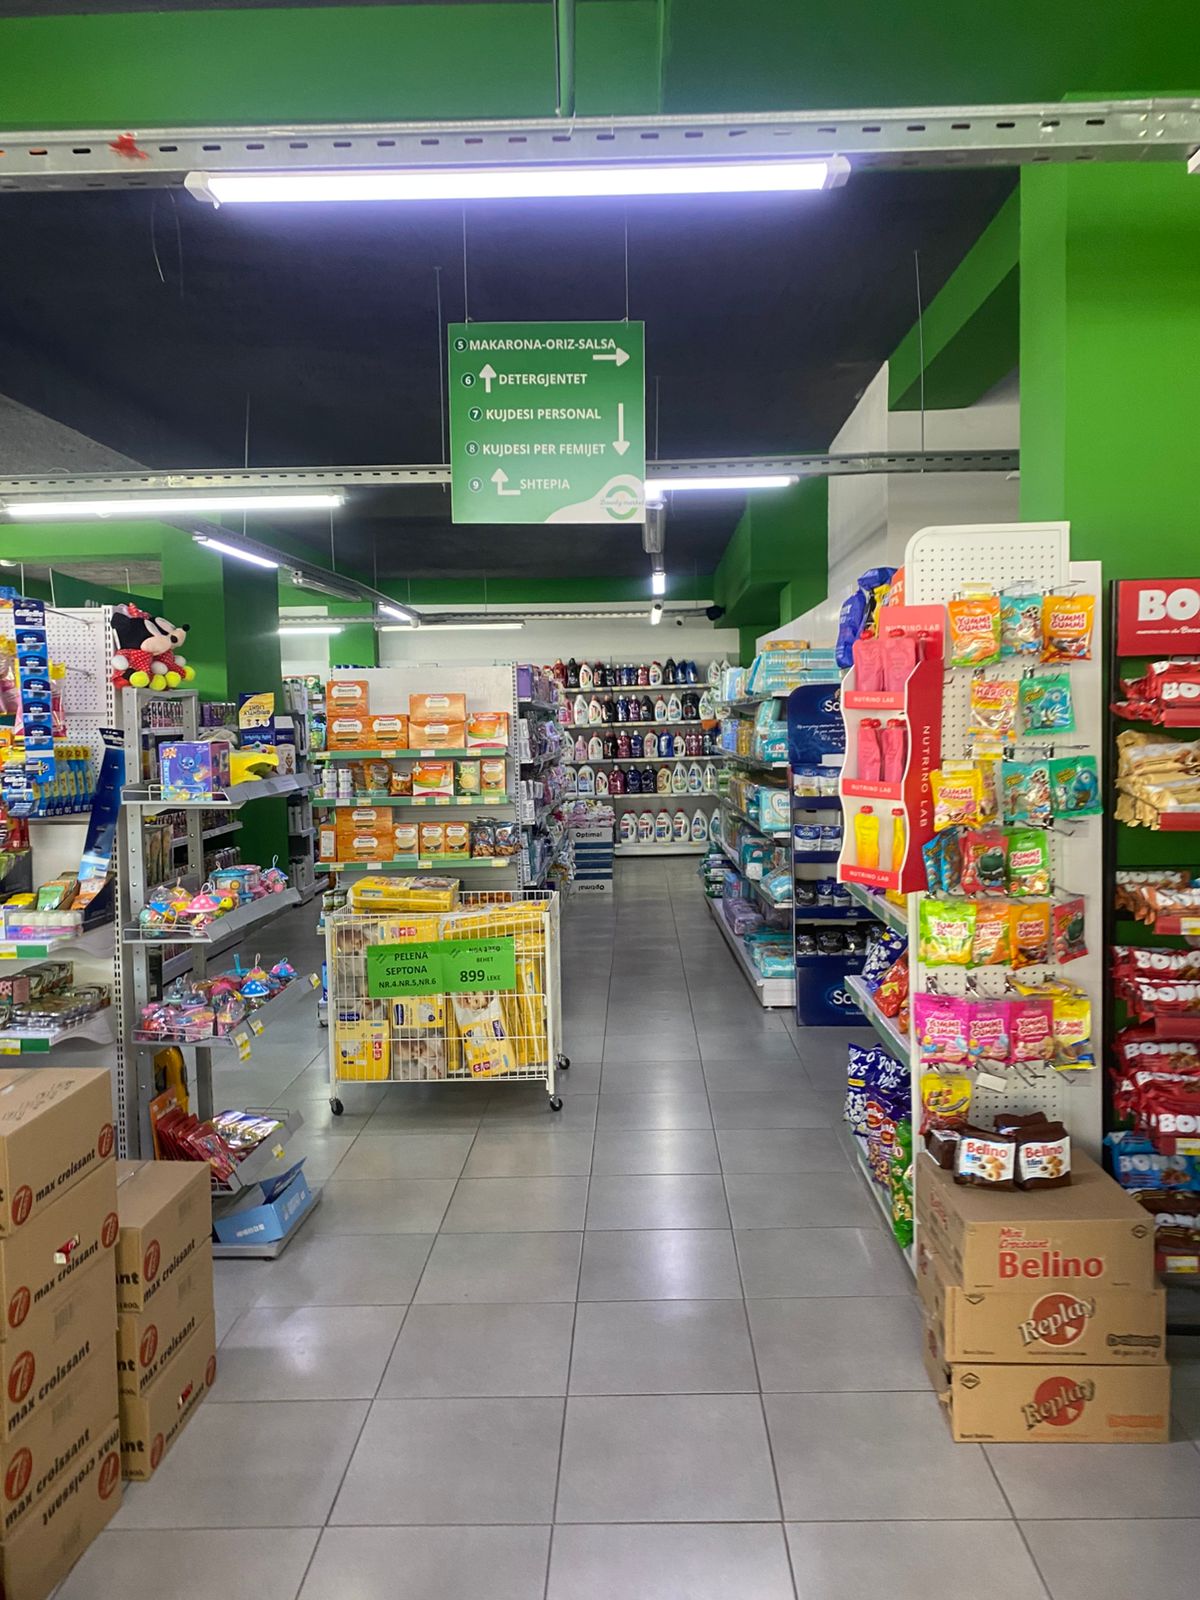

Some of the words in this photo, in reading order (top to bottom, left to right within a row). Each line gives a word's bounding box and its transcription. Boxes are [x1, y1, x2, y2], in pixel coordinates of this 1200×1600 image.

[458, 340, 464, 350] 5
[470, 339, 616, 350] MAKARONA-ORIZ-SALSA
[465, 376, 472, 384] 6
[499, 374, 587, 386] DETERGJENTET
[472, 410, 478, 418] 7
[486, 409, 534, 422] KUJDESI
[537, 408, 602, 420] PERSONAL
[470, 444, 475, 453] 8
[482, 444, 530, 456] KUJDESI
[534, 444, 556, 454] PER
[560, 444, 606, 456] FEMIJET
[473, 481, 478, 490] 9
[520, 479, 570, 490] SHTEPIA
[922, 726, 930, 793] NUTRINO
[920, 800, 928, 827] LAB
[386, 965, 428, 976] SEPTONA
[394, 952, 428, 962] PELENA
[460, 970, 485, 982] 899
[967, 1142, 1008, 1158] Belino
[1025, 1145, 1064, 1158] Belino
[36, 1180, 55, 1202] max
[58, 1148, 95, 1185] croissant
[34, 1278, 55, 1303] max
[58, 1240, 98, 1282] croissant
[144, 1278, 160, 1304] max
[162, 1238, 195, 1282] croissant
[1000, 1251, 1104, 1278] Belino
[1018, 1298, 1096, 1346] Replay
[140, 1361, 158, 1390] max
[160, 1316, 195, 1365] croissant
[8, 1396, 35, 1432] max
[38, 1340, 90, 1400] croissant
[1020, 1378, 1096, 1431] Replay
[5, 1490, 32, 1530] max
[36, 1428, 90, 1494] croissant
[42, 1457, 95, 1526] croissant
